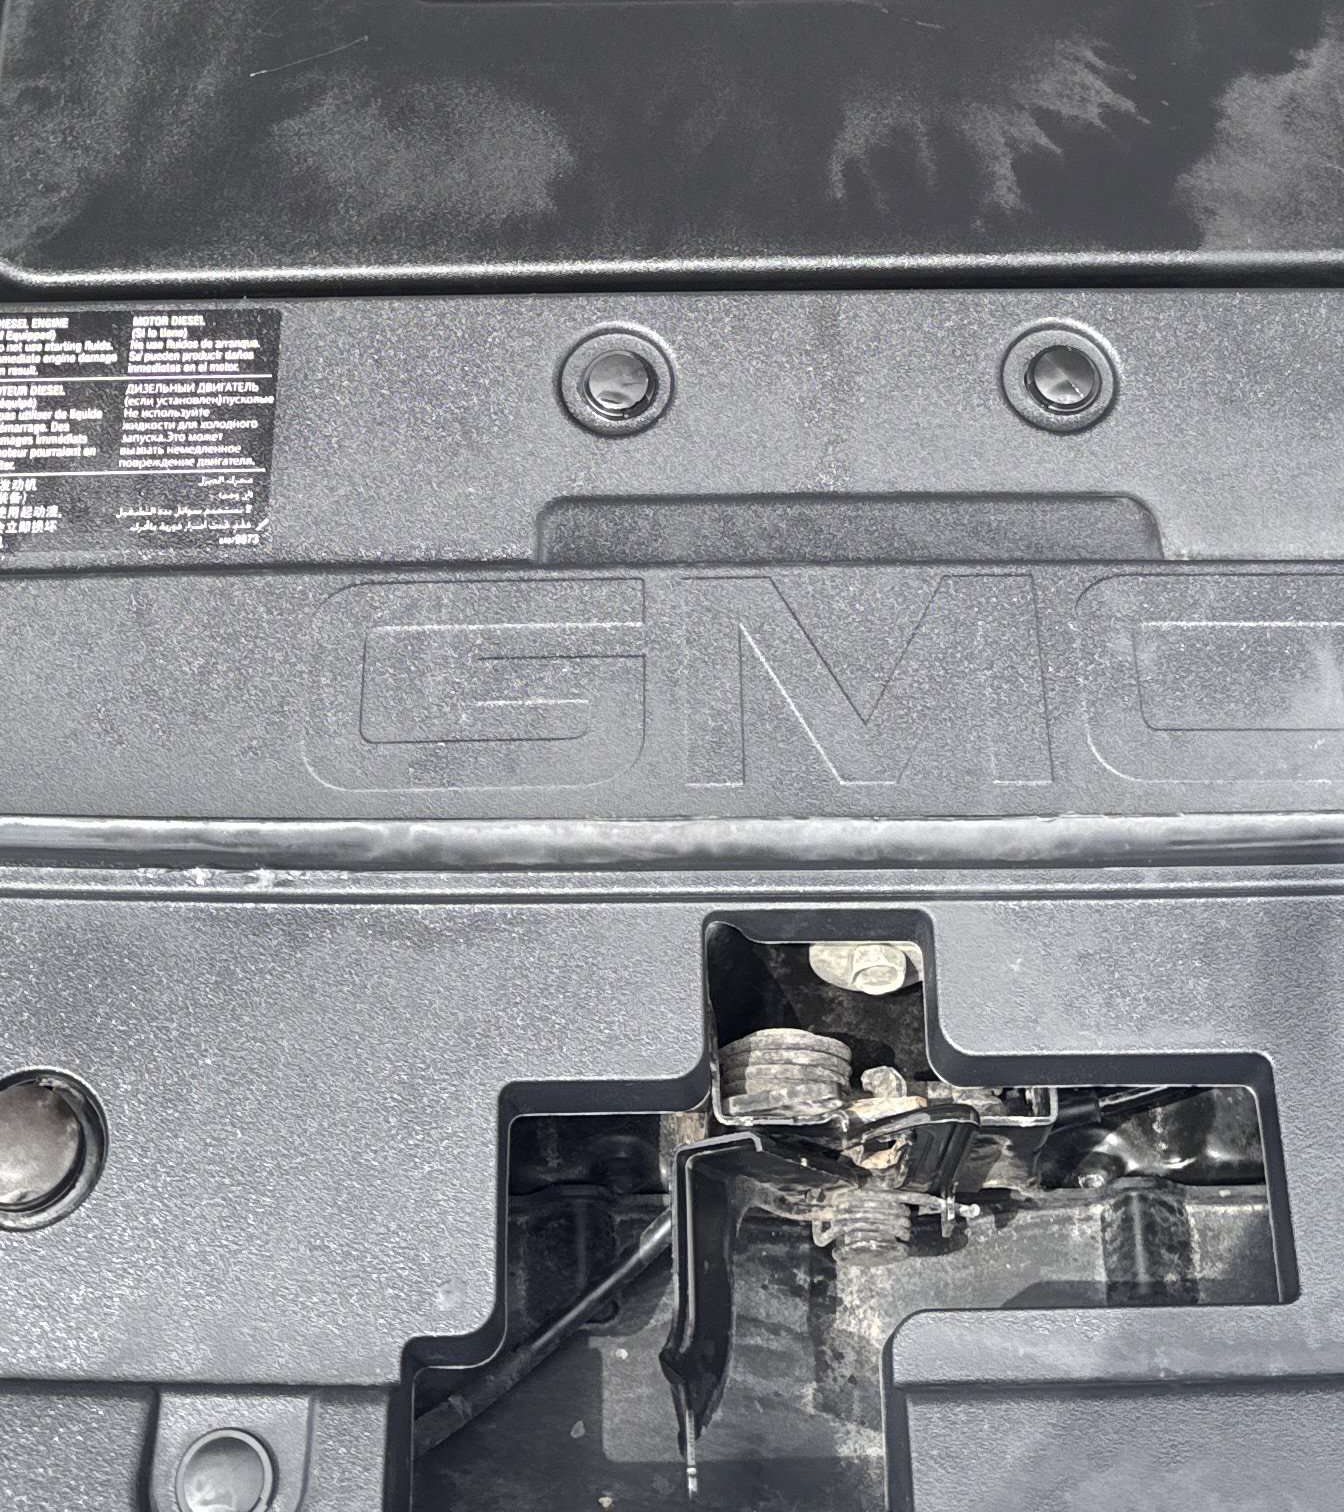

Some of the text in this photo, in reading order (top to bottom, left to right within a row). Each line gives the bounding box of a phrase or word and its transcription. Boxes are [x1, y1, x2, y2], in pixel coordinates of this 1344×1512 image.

[31, 318, 69, 328] ENGINE
[133, 315, 205, 326] MOTOR DIESEL
[6, 330, 56, 342] Equipped)
[7, 343, 22, 351] not
[45, 342, 82, 353] starting
[201, 339, 213, 348] de
[43, 353, 76, 365] engine
[78, 353, 117, 364] damage
[144, 351, 180, 362] pueden
[182, 351, 223, 362] producir
[184, 364, 196, 372] en
[198, 363, 207, 372] el
[30, 385, 65, 396] DIESEL
[197, 382, 259, 393] ДВИГАТЕЛЬ
[54, 410, 67, 419] de
[124, 409, 139, 418] Не
[51, 422, 70, 432] Des
[122, 420, 258, 431] жидкости для холодного
[167, 445, 241, 455] немедленное
[119, 459, 195, 468] повреждение
